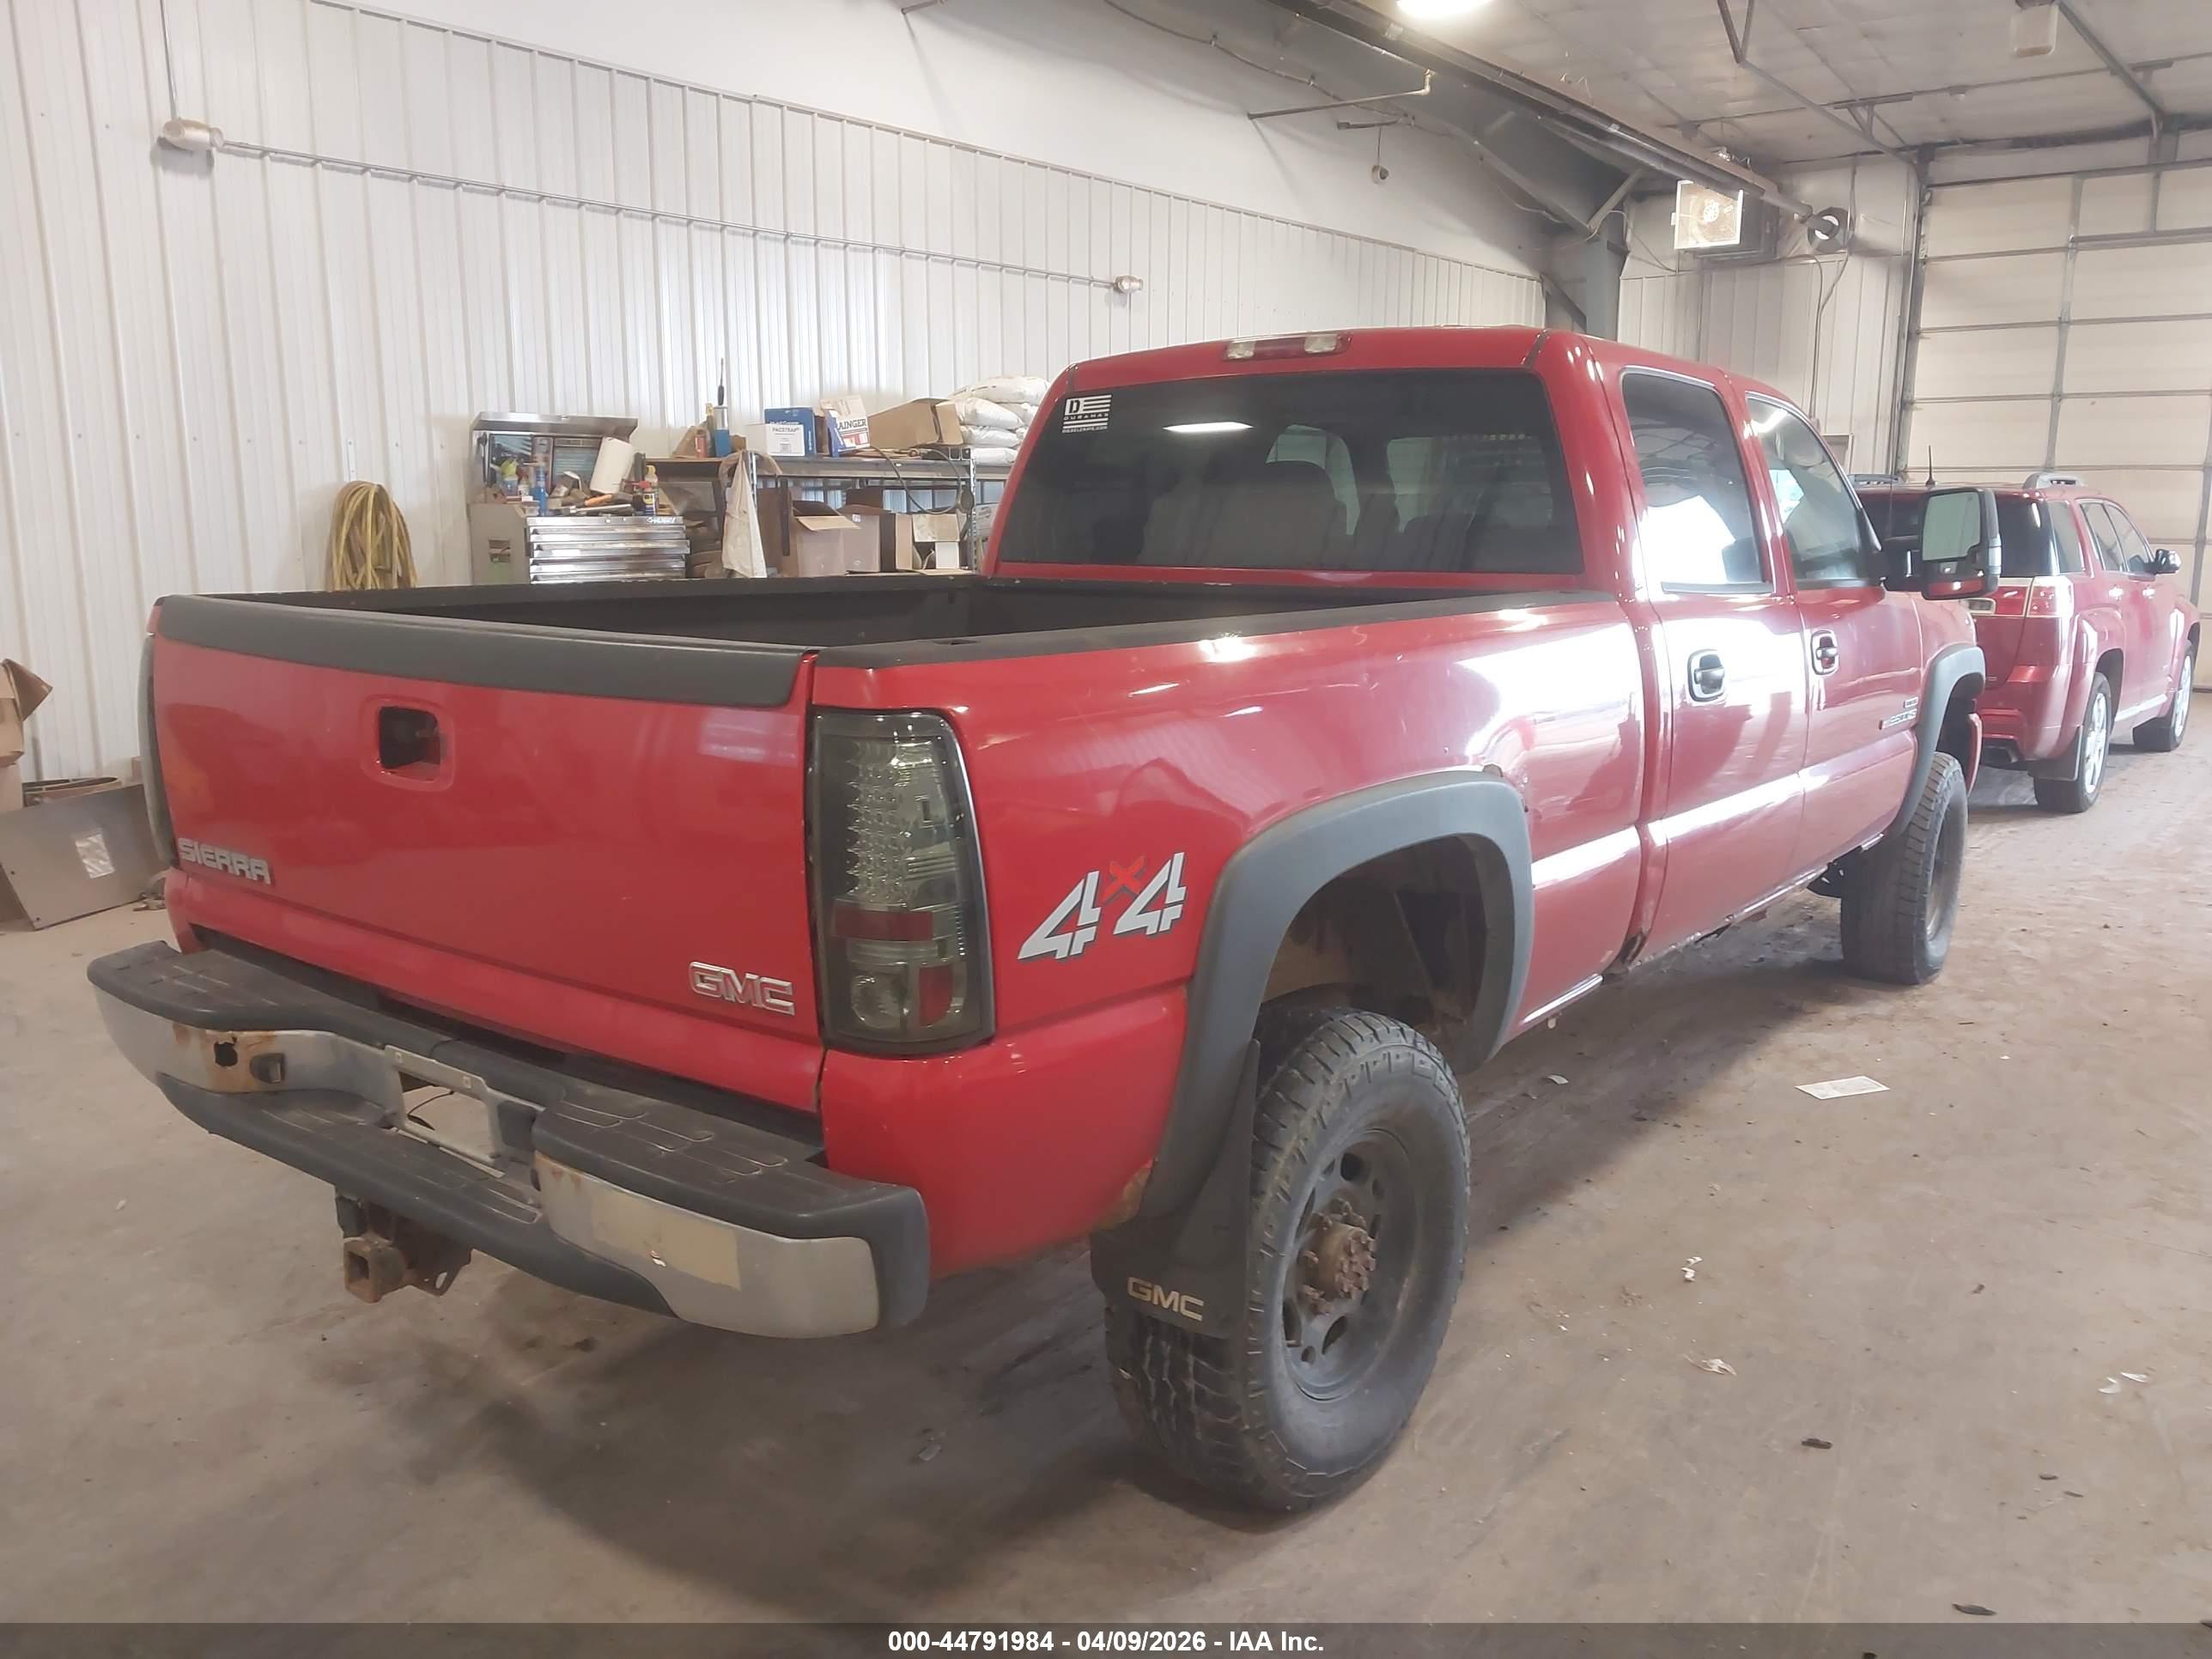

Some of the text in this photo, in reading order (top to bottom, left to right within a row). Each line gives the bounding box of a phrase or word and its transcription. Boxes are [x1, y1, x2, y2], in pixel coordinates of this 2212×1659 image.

[839, 419, 867, 430] AINGER
[177, 837, 272, 885] SIERRA
[689, 961, 795, 1016] GMC
[1127, 1277, 1204, 1322] GMC
